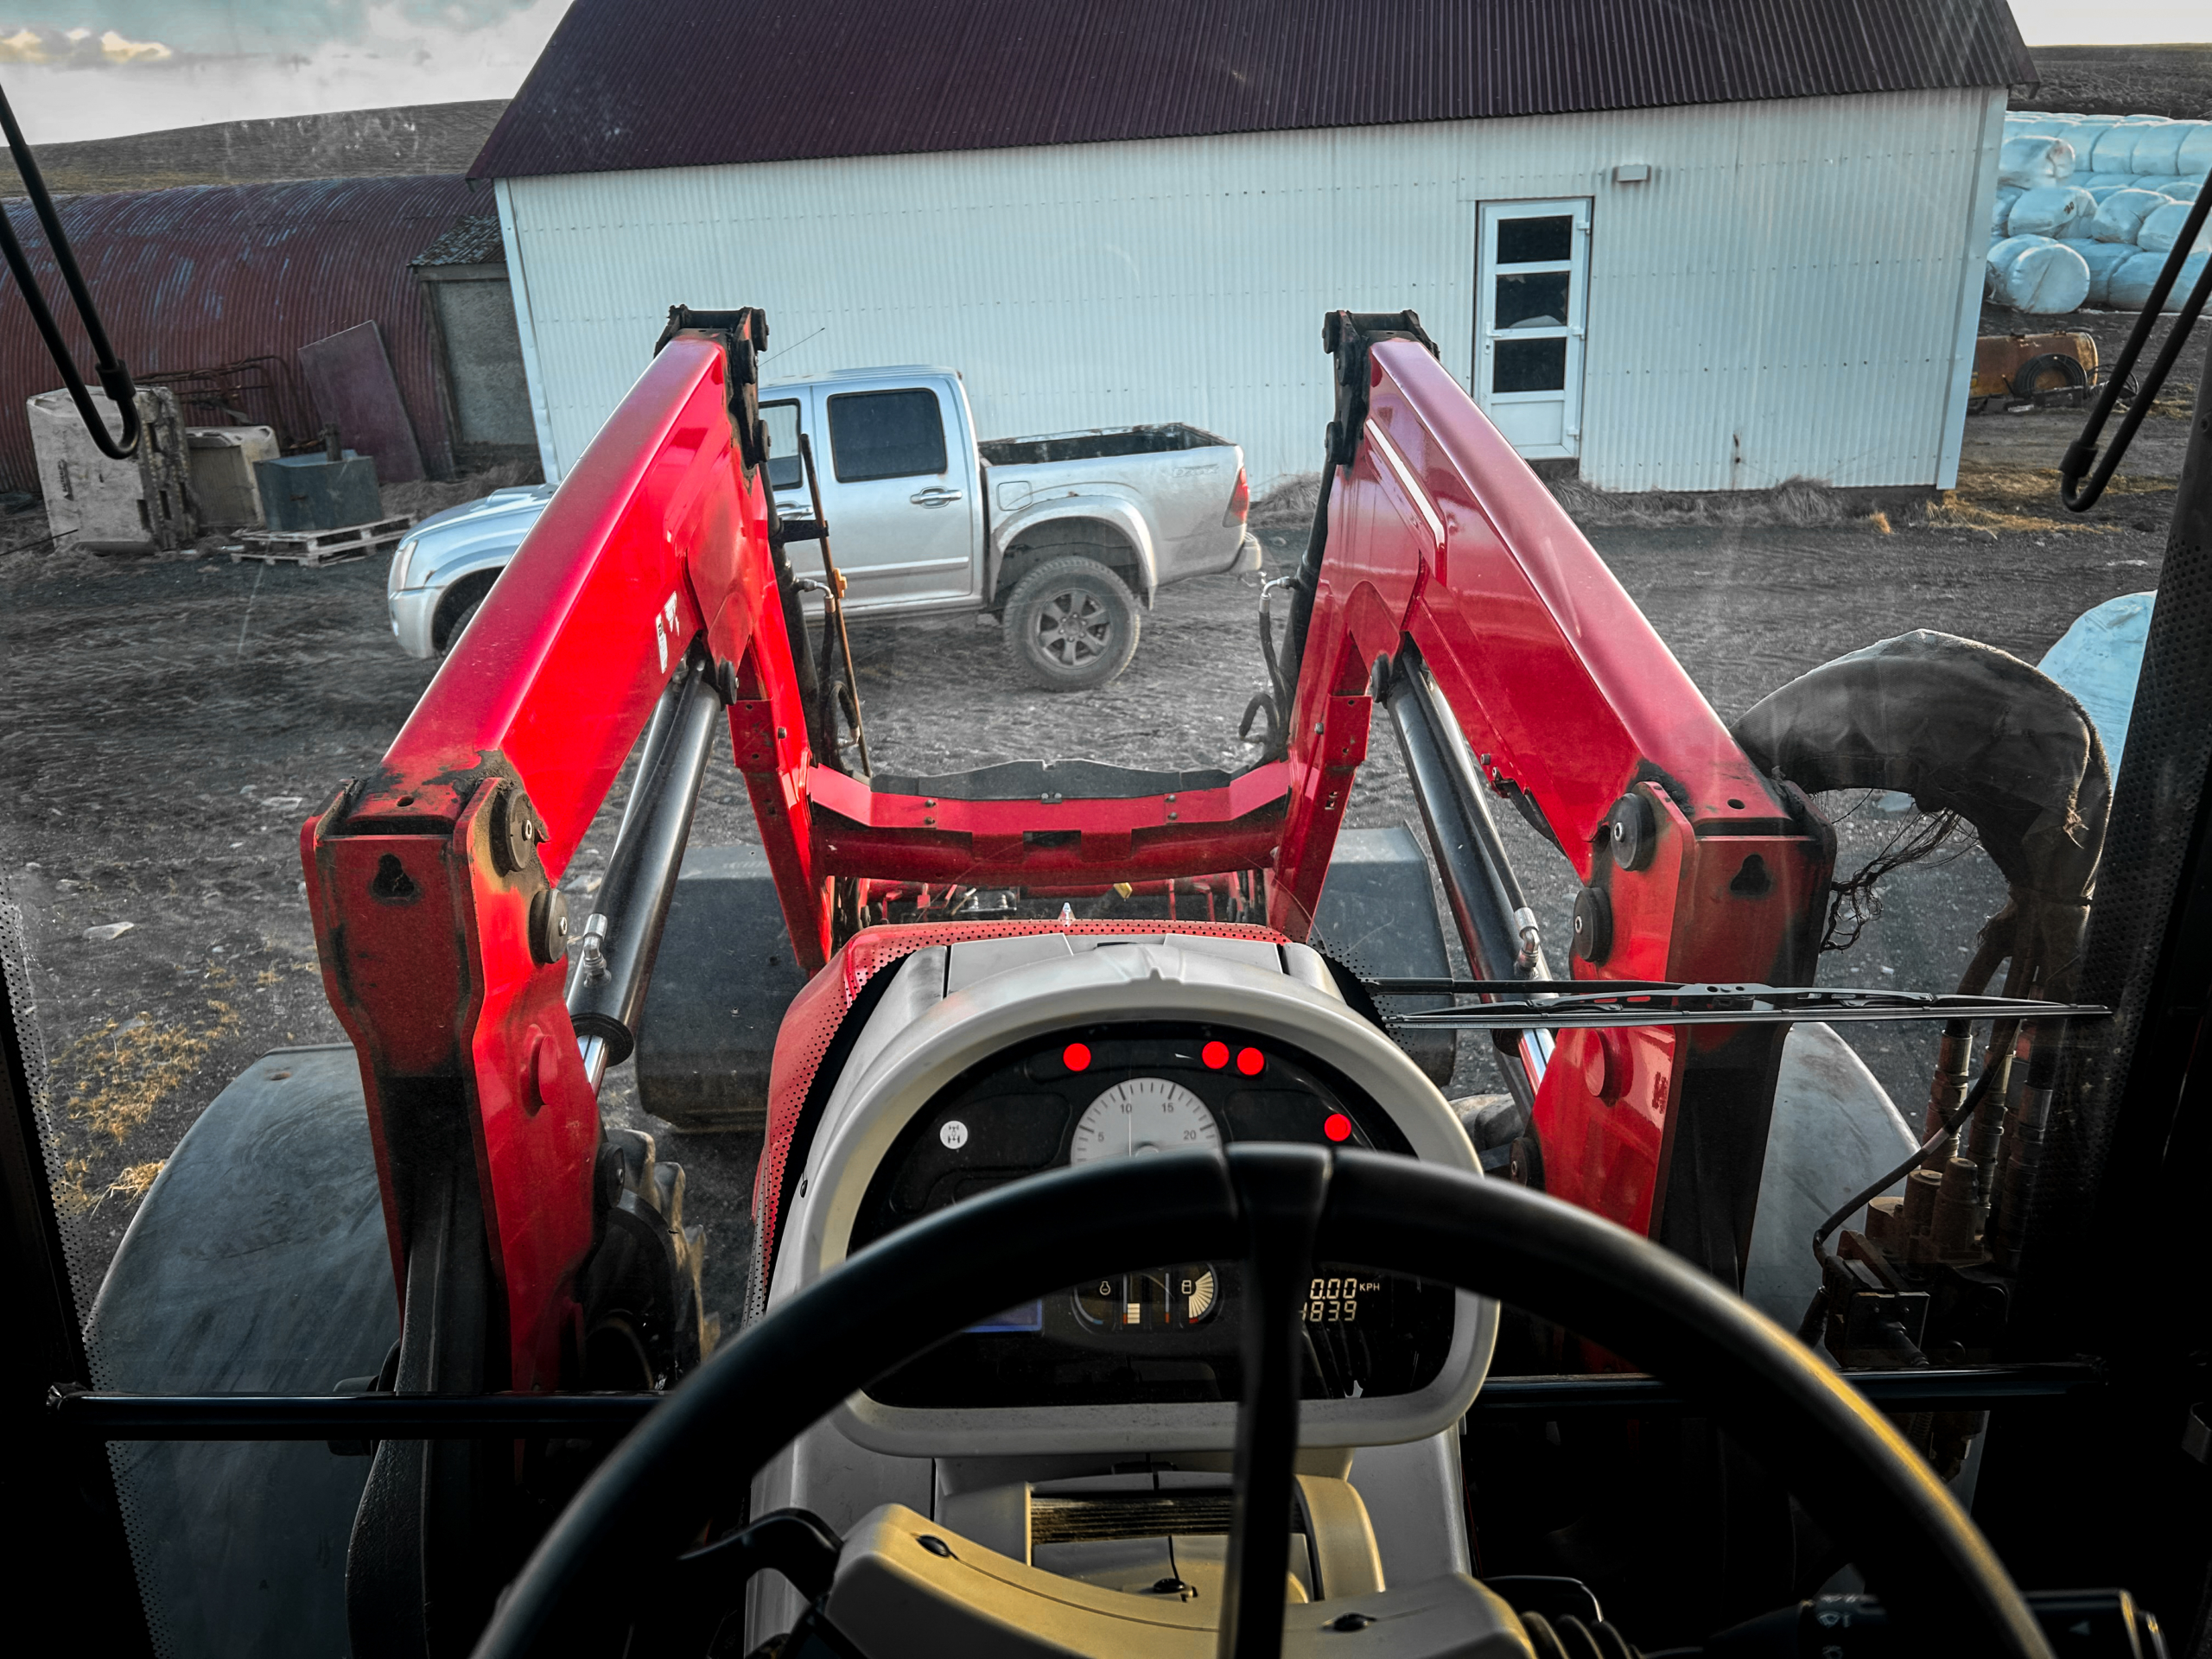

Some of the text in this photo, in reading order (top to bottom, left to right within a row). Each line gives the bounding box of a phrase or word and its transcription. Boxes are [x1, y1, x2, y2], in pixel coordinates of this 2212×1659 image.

[1120, 1103, 1133, 1114] 10
[1162, 1103, 1174, 1114] 15
[1097, 1132, 1104, 1142] 5
[1183, 1130, 1197, 1141] 20
[1309, 1278, 1380, 1300] 0.00 KPH
